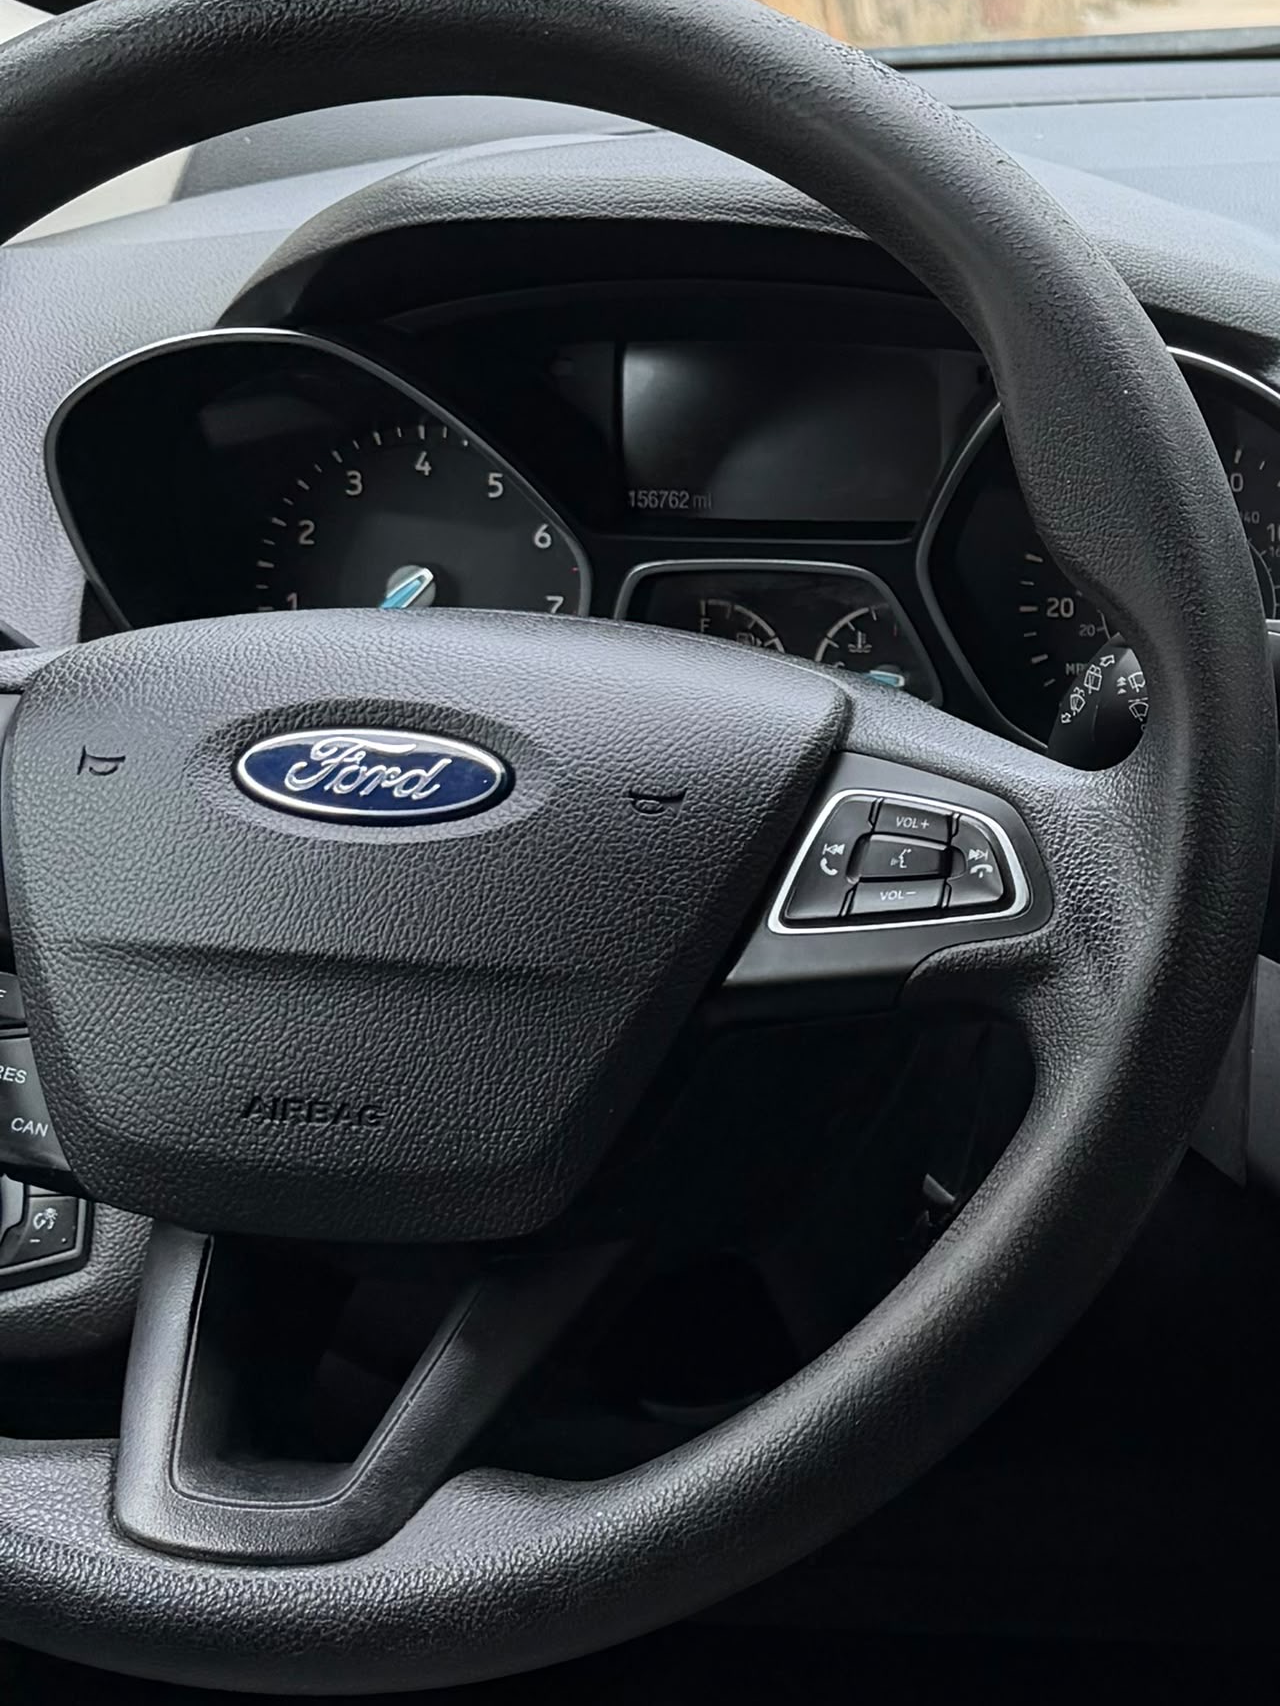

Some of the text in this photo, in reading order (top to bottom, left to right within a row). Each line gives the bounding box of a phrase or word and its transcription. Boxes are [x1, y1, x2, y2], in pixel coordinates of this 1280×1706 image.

[415, 451, 432, 476] 4
[346, 470, 363, 495] 3
[488, 473, 504, 499] 5
[628, 490, 690, 509] 156762
[298, 520, 316, 545] 2
[533, 524, 552, 549] 6
[1046, 597, 1075, 619] 20
[1079, 624, 1096, 637] 20
[284, 736, 452, 801] Ford
[240, 1095, 391, 1128] AIRBAG
[11, 1117, 49, 1138] CAN
